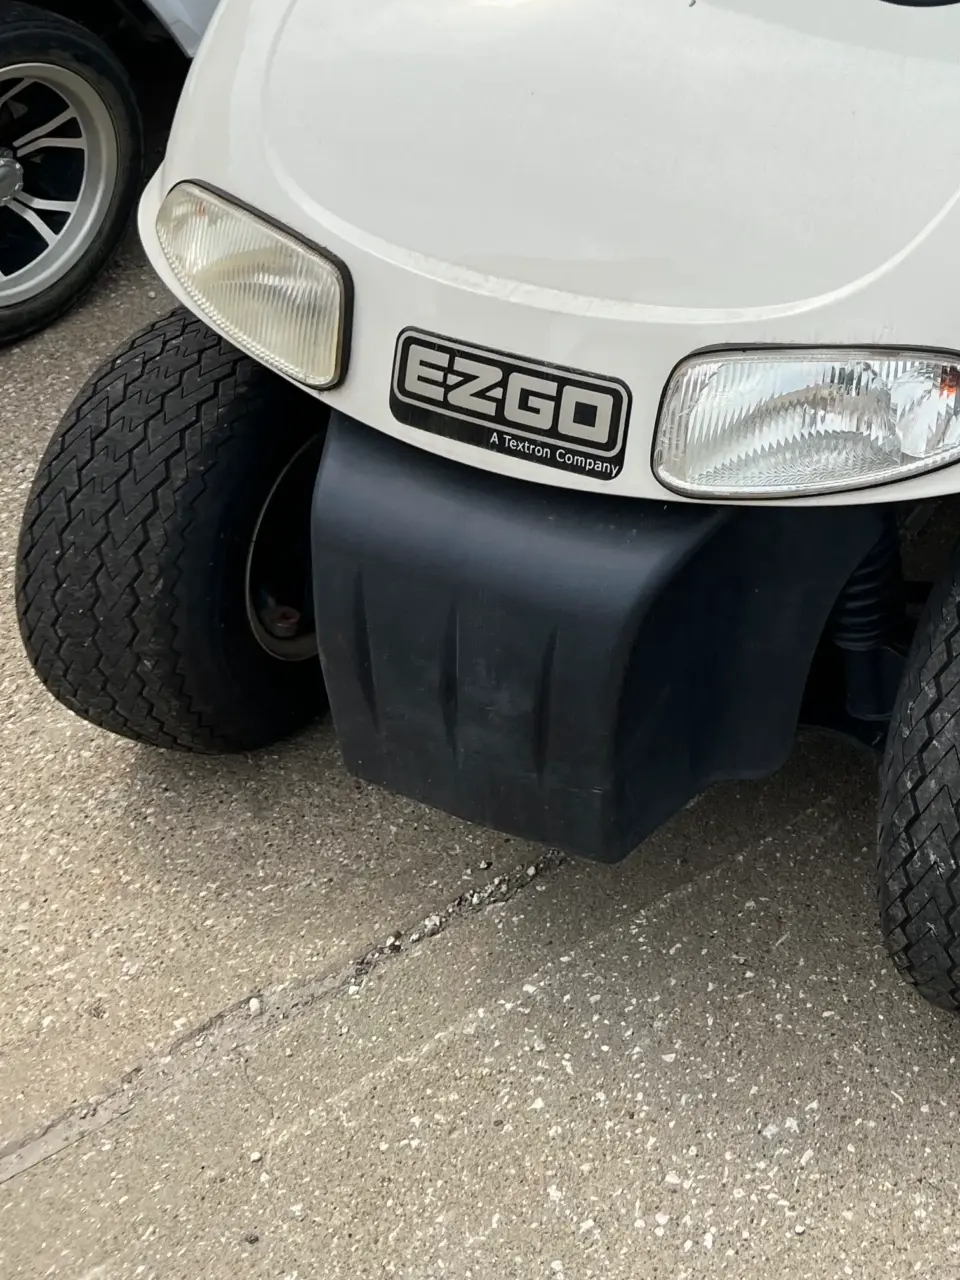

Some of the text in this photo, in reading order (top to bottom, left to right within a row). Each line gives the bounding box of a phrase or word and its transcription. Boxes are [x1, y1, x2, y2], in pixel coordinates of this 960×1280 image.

[490, 432, 620, 477] A Textron Company
